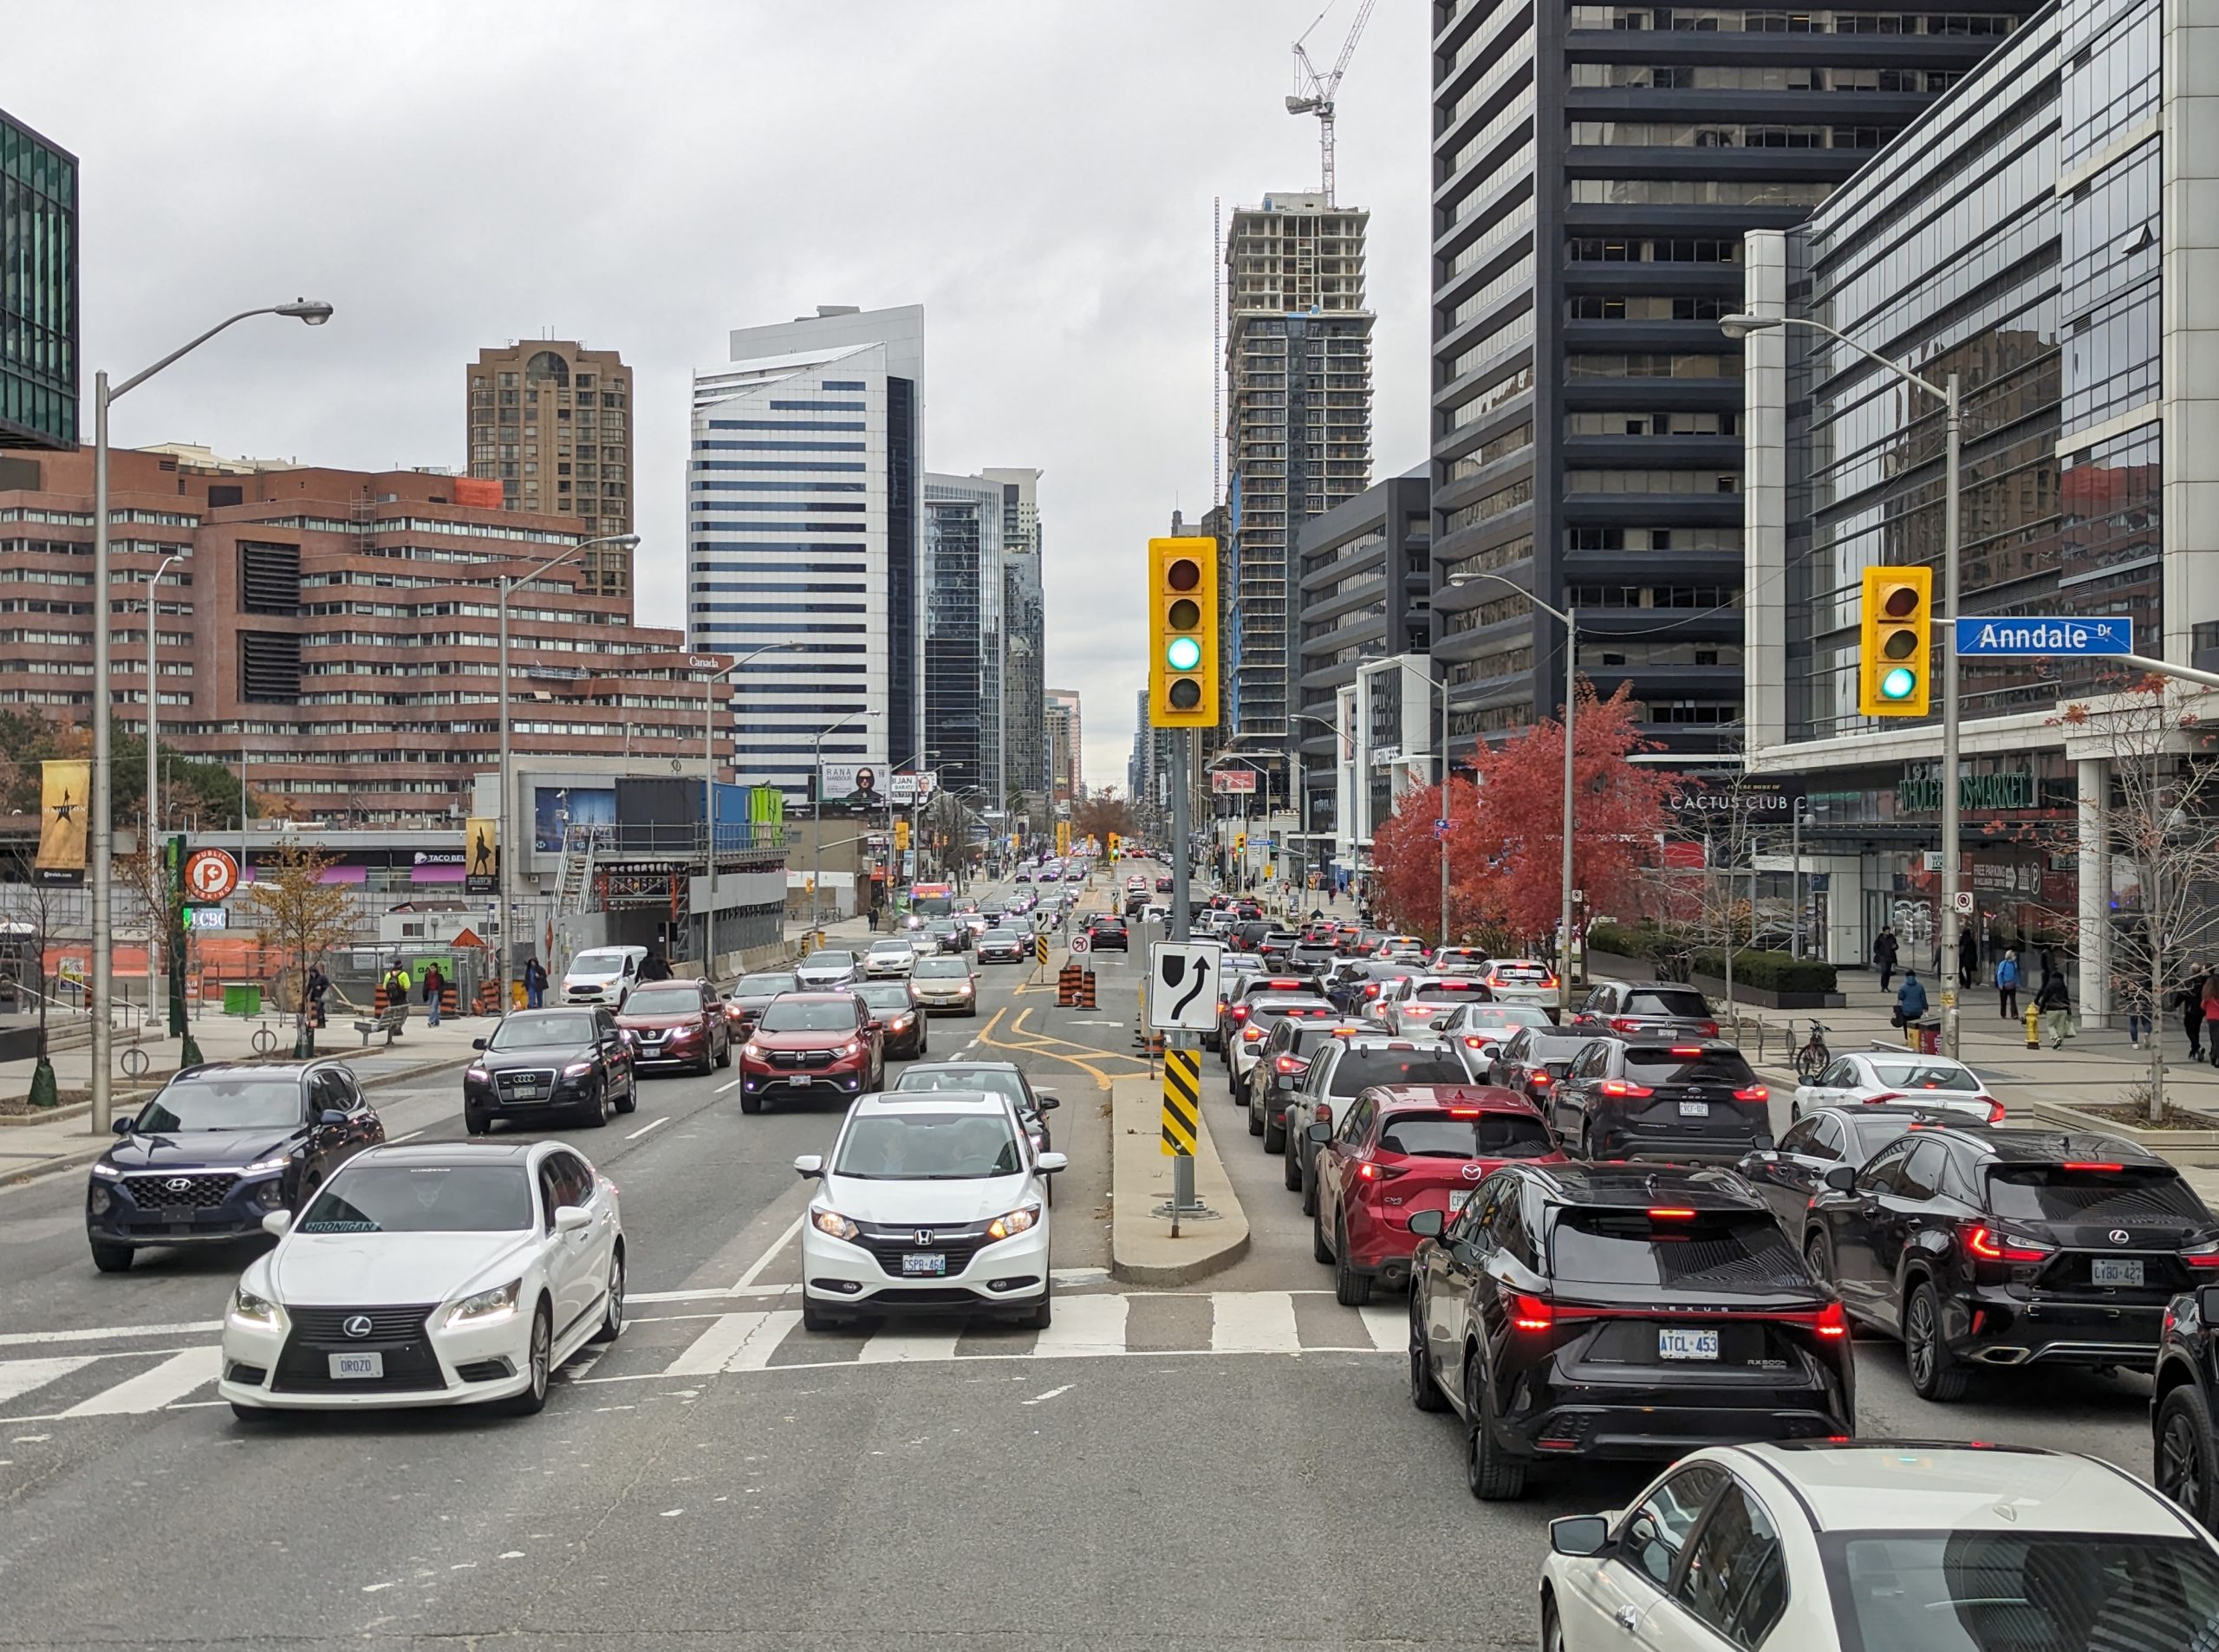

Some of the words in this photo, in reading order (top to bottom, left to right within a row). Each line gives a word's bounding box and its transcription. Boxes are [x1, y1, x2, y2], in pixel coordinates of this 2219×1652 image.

[1980, 624, 2087, 648] Anndale
[2098, 624, 2112, 637] Dr
[689, 655, 719, 668] Canada
[1899, 779, 1936, 811] WHOLE
[1974, 771, 2027, 810] MARKET
[1670, 796, 1740, 810] CACTUS
[1746, 796, 1787, 810] CLUB
[196, 850, 227, 861] PUBLIC
[203, 864, 223, 890] P
[306, 1221, 374, 1231] HOONIGAN
[929, 1259, 944, 1270] 464
[1661, 1337, 1689, 1352] ATCL
[1696, 1337, 1717, 1352] 453
